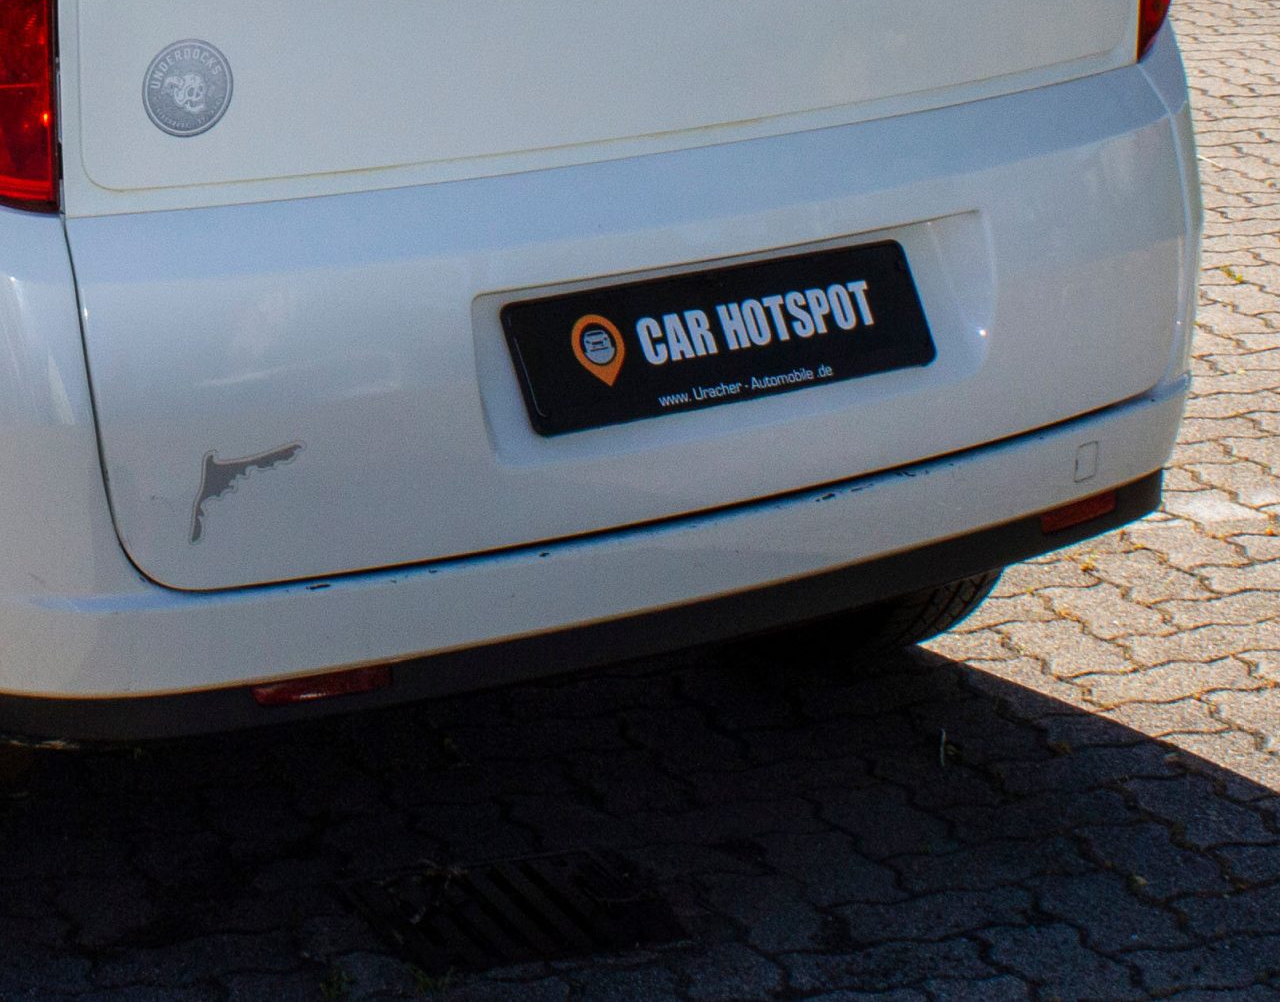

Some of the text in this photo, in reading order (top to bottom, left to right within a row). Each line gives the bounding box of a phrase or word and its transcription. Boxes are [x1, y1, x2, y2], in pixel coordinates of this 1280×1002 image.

[149, 47, 223, 89] UNDERDOCKS
[635, 280, 875, 366] CAR HOTSPOT
[692, 381, 743, 401] Uracher
[751, 368, 814, 389] Automobile
